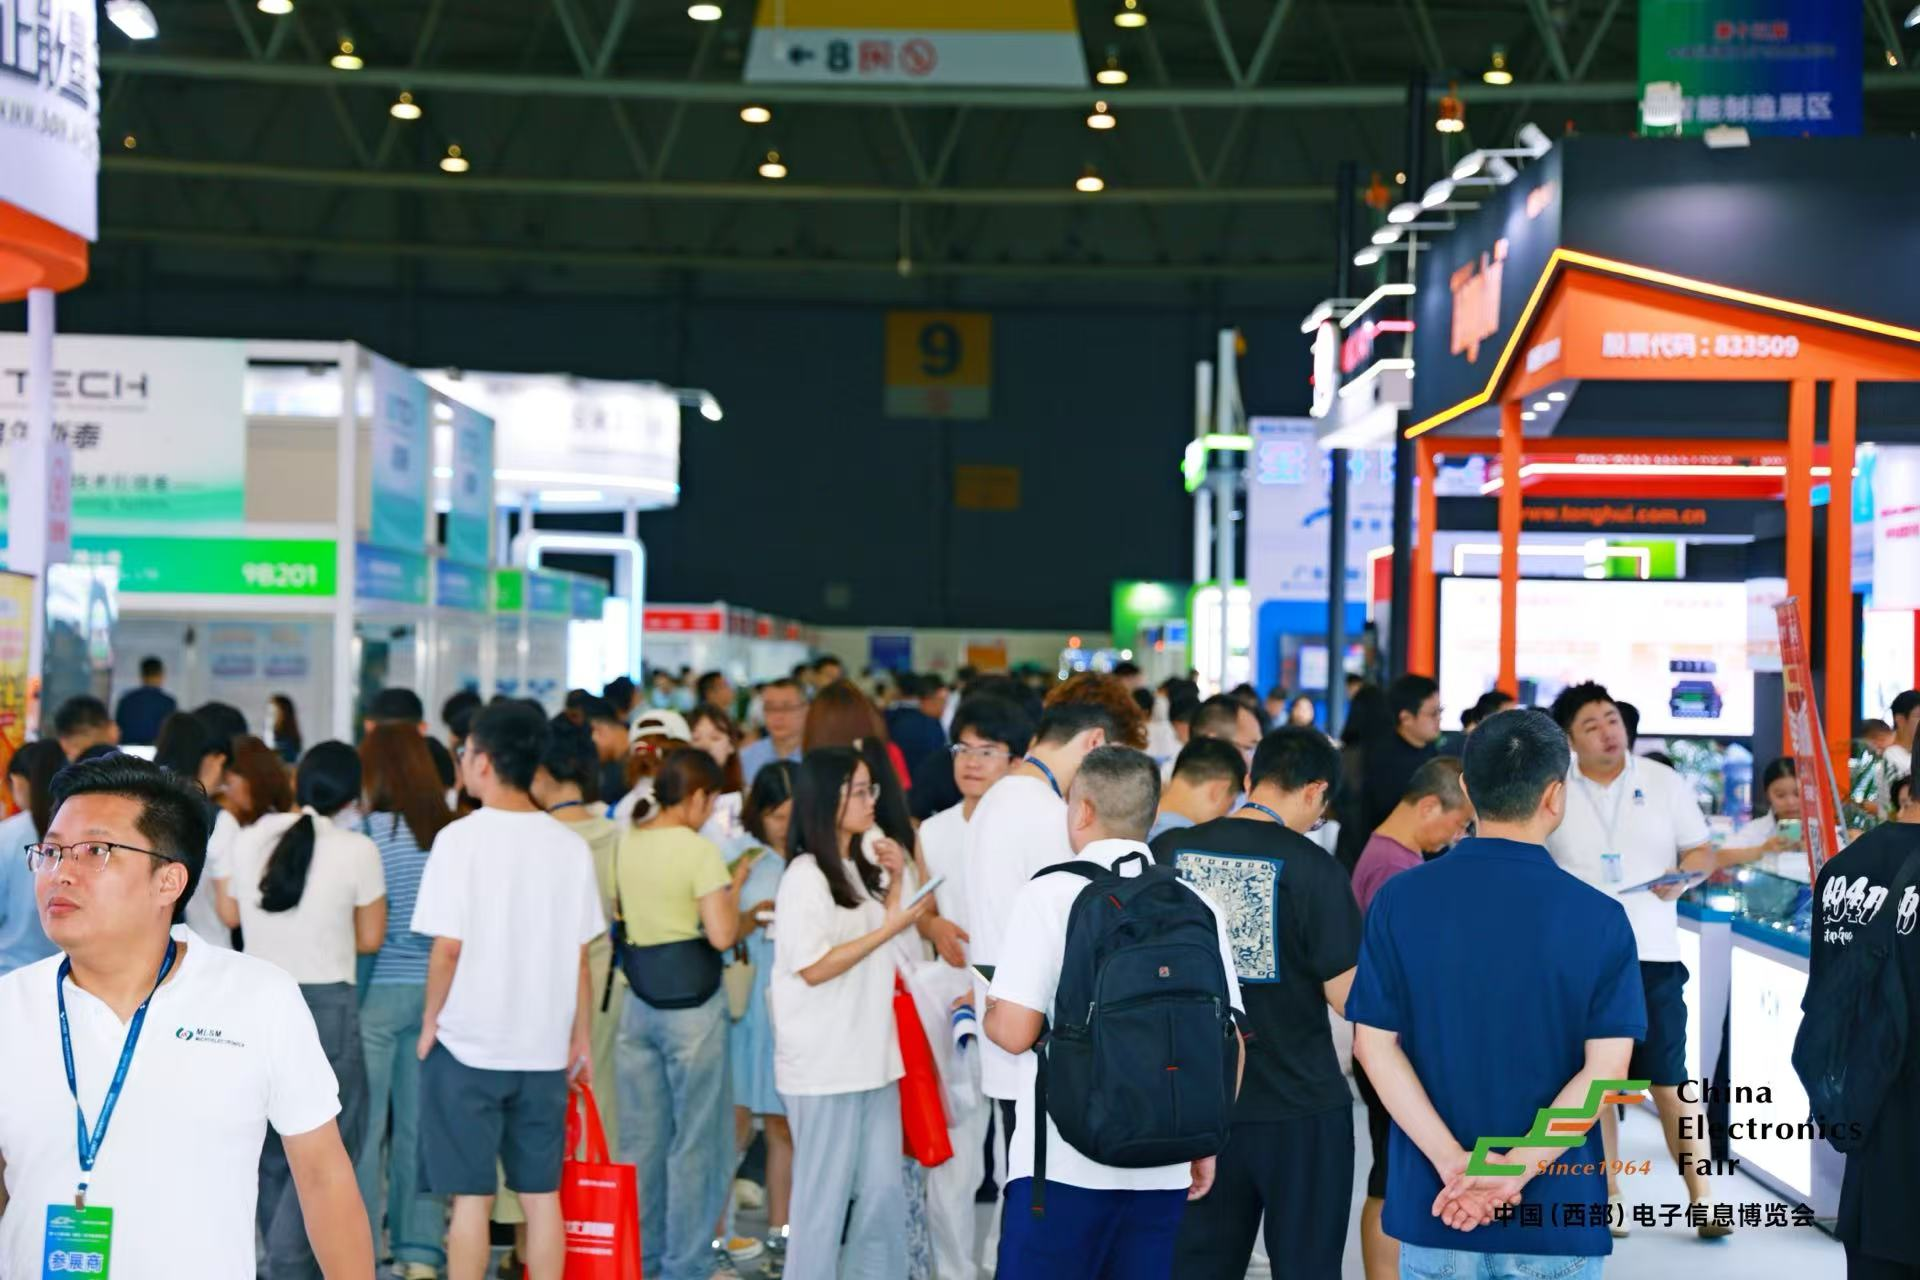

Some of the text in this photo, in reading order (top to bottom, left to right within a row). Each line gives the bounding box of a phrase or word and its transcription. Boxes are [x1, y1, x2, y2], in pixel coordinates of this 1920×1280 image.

[826, 39, 851, 73] 8
[918, 320, 964, 378] 9
[241, 562, 319, 588] 9B201
[49, 1250, 104, 1273] 参展商
